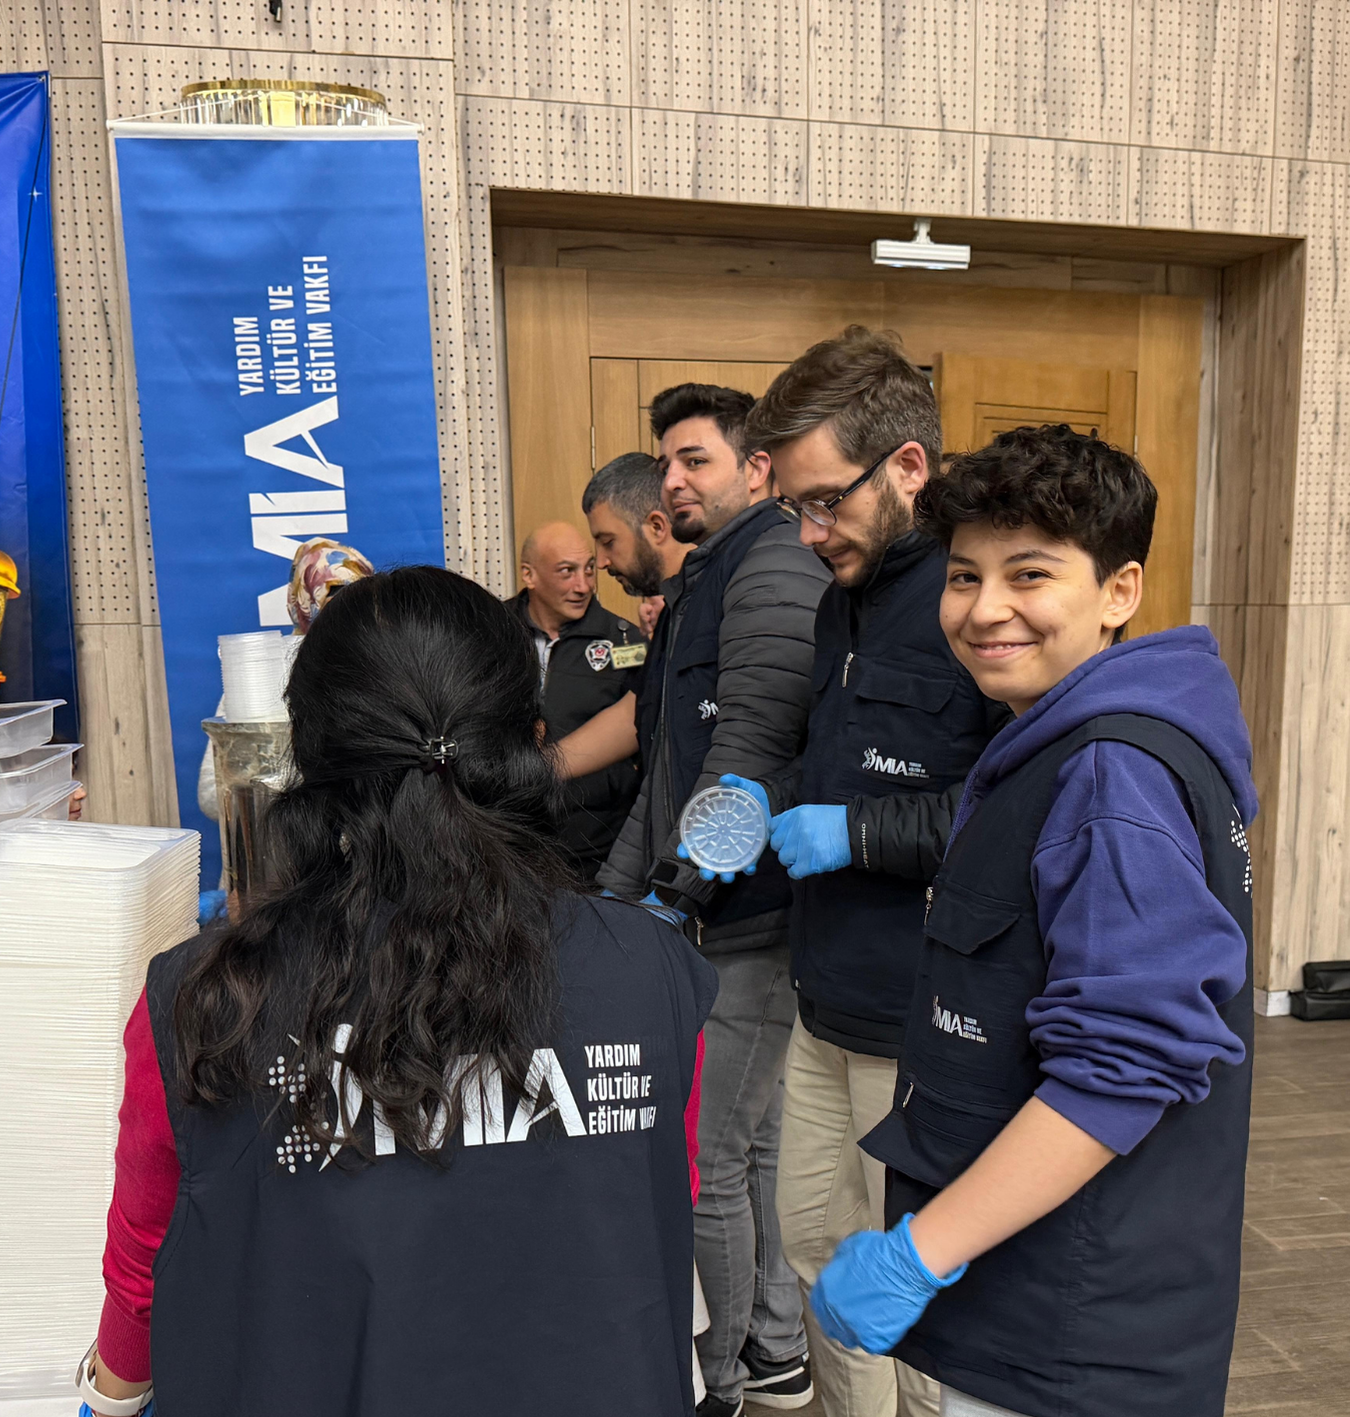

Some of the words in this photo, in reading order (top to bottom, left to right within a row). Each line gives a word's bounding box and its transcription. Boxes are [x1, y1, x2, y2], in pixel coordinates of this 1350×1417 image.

[268, 285, 294, 311] VE
[302, 255, 331, 315] VAKFI
[233, 317, 265, 396] YARDIM
[266, 318, 301, 395] KÜLTÜR
[303, 322, 338, 393] EĞİTİM
[584, 1044, 640, 1068] YARDIM
[587, 1072, 639, 1102] KÜLTÜR
[588, 1105, 637, 1135] EĞİTİM
